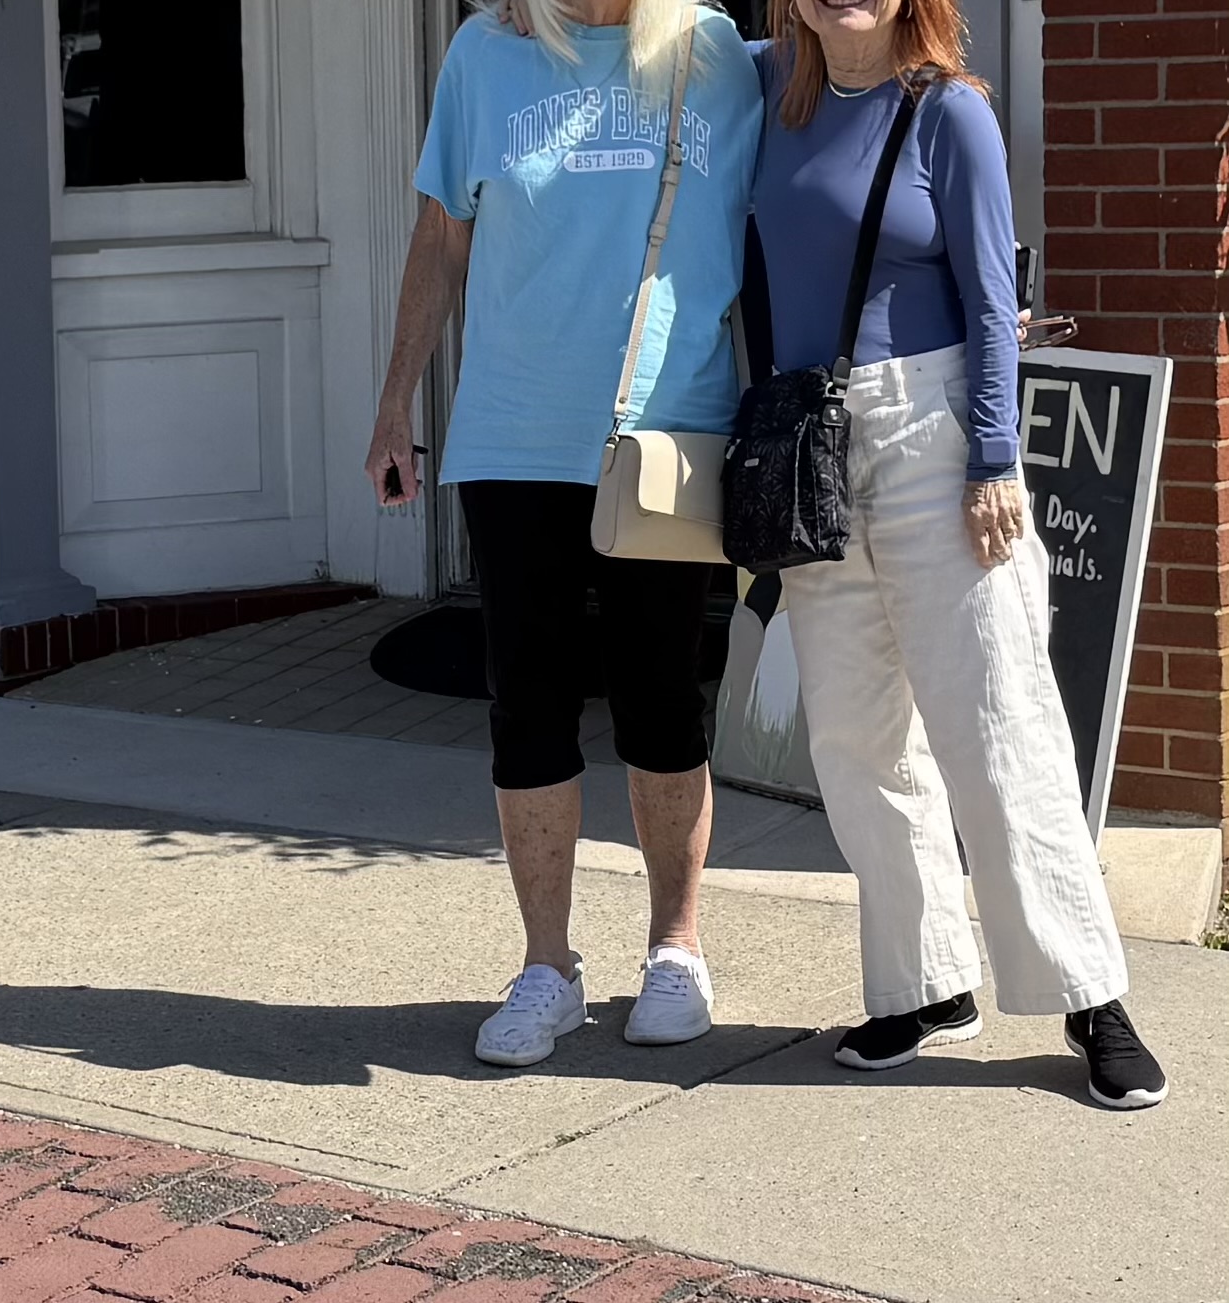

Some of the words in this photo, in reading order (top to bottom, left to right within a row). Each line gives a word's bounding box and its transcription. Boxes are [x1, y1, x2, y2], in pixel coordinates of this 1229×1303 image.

[501, 87, 602, 172] JONES
[574, 154, 606, 169] EST.
[611, 151, 646, 167] 1929
[1045, 494, 1098, 544] Day.
